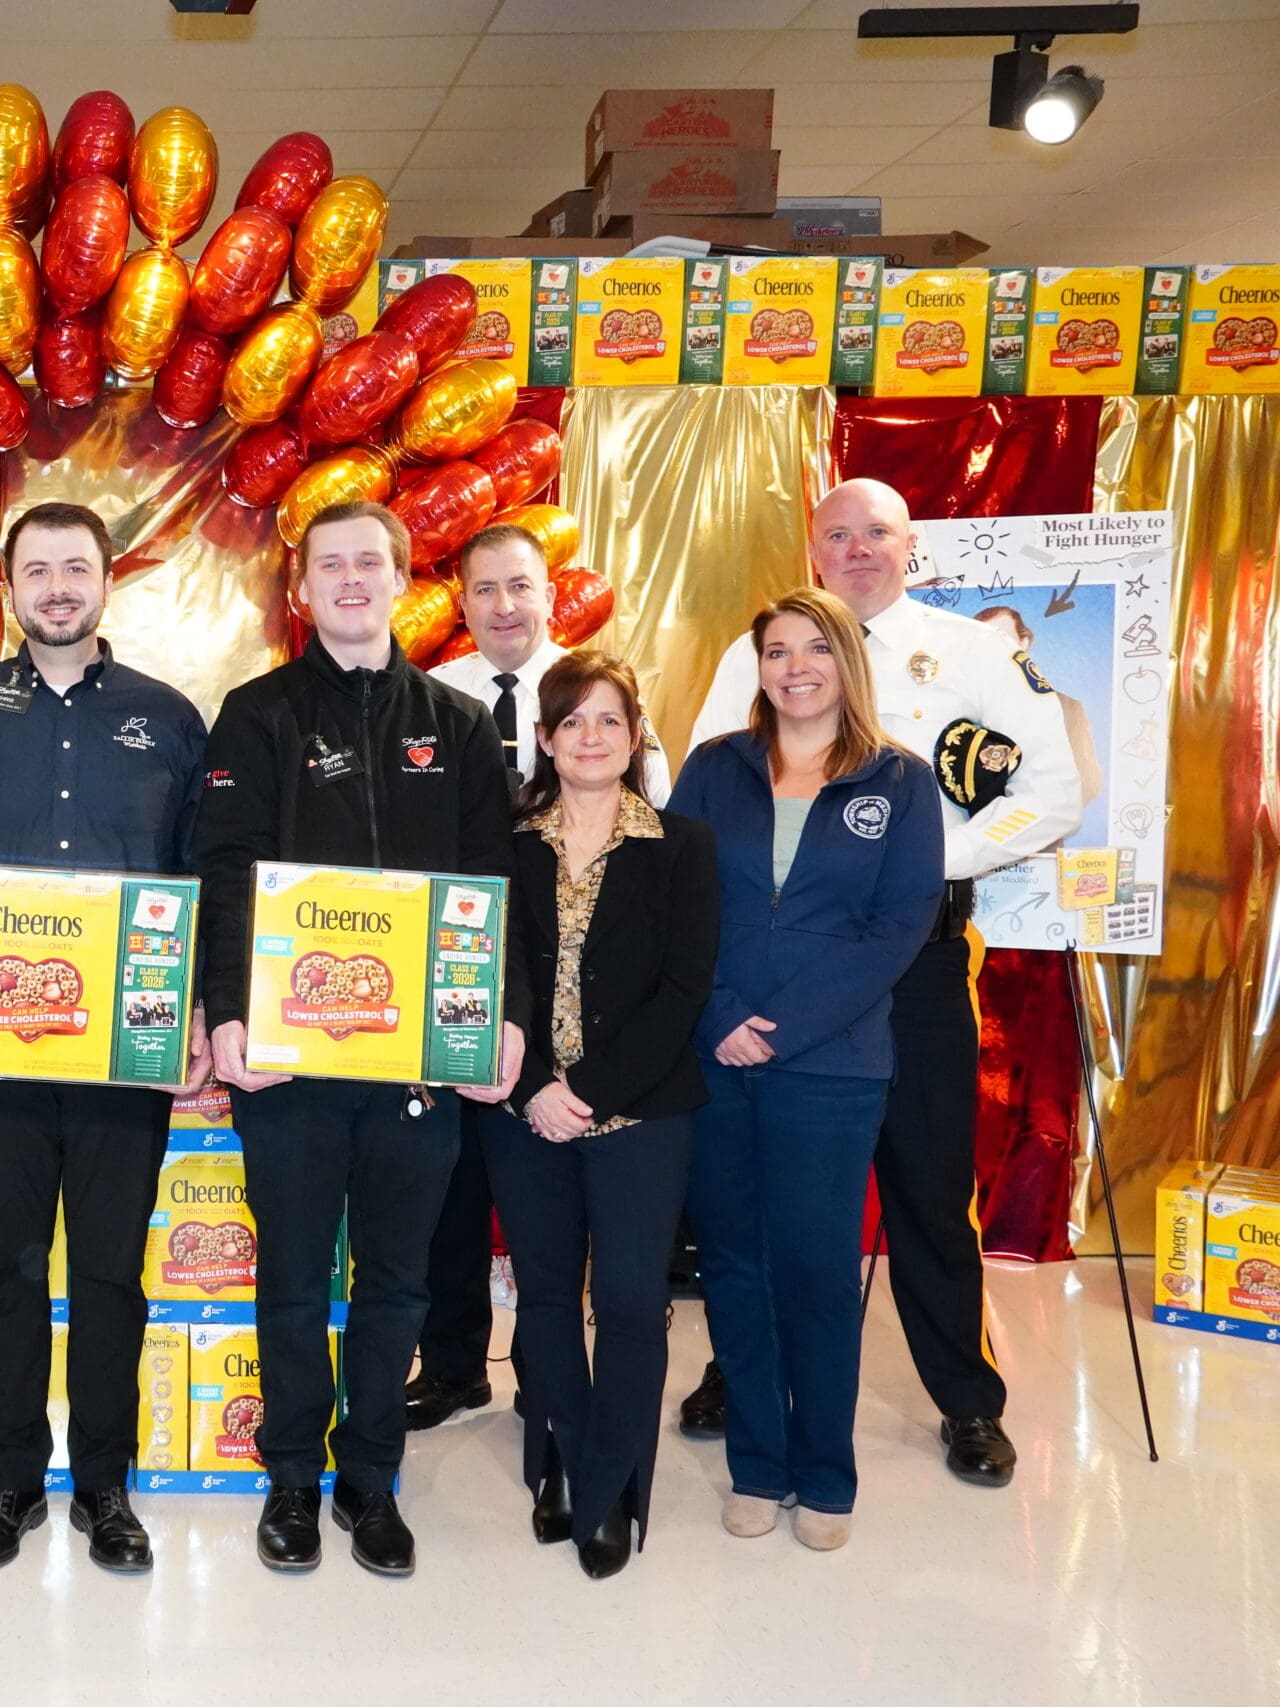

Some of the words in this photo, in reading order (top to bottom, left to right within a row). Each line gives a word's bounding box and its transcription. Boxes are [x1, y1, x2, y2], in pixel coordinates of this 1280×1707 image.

[475, 280, 509, 297] erios
[603, 279, 661, 296] Cheerios
[754, 278, 814, 296] Cheerios
[906, 290, 965, 308] Cheerios
[1061, 288, 1120, 306] Cheerios
[1220, 286, 1280, 304] Cheerios
[1042, 519, 1083, 533] Most
[1088, 517, 1142, 533] Likely
[1146, 517, 1165, 530] to
[1045, 533, 1089, 550] Fight
[1094, 532, 1162, 547] Hunger
[324, 760, 344, 771] RYAN
[212, 769, 230, 778] give
[213, 778, 235, 787] here.
[296, 900, 392, 934] Cheerios
[48, 942, 73, 951] OATS
[357, 939, 383, 947] OATS
[142, 976, 164, 988] 2026
[453, 973, 475, 985] 2026
[11, 1014, 72, 1024] CHOLESTEROL
[288, 1010, 319, 1020] LOWER
[321, 1011, 382, 1020] CHOLESTEROL
[198, 1097, 230, 1106] CHOLEST
[1239, 1223, 1280, 1247] Chee
[1168, 1216, 1188, 1271] Cheerios
[167, 1271, 194, 1279] LOWER
[195, 1268, 248, 1278] CHOLESTEROL
[1233, 1295, 1259, 1304] LOWER
[221, 1445, 248, 1453] LOWER
